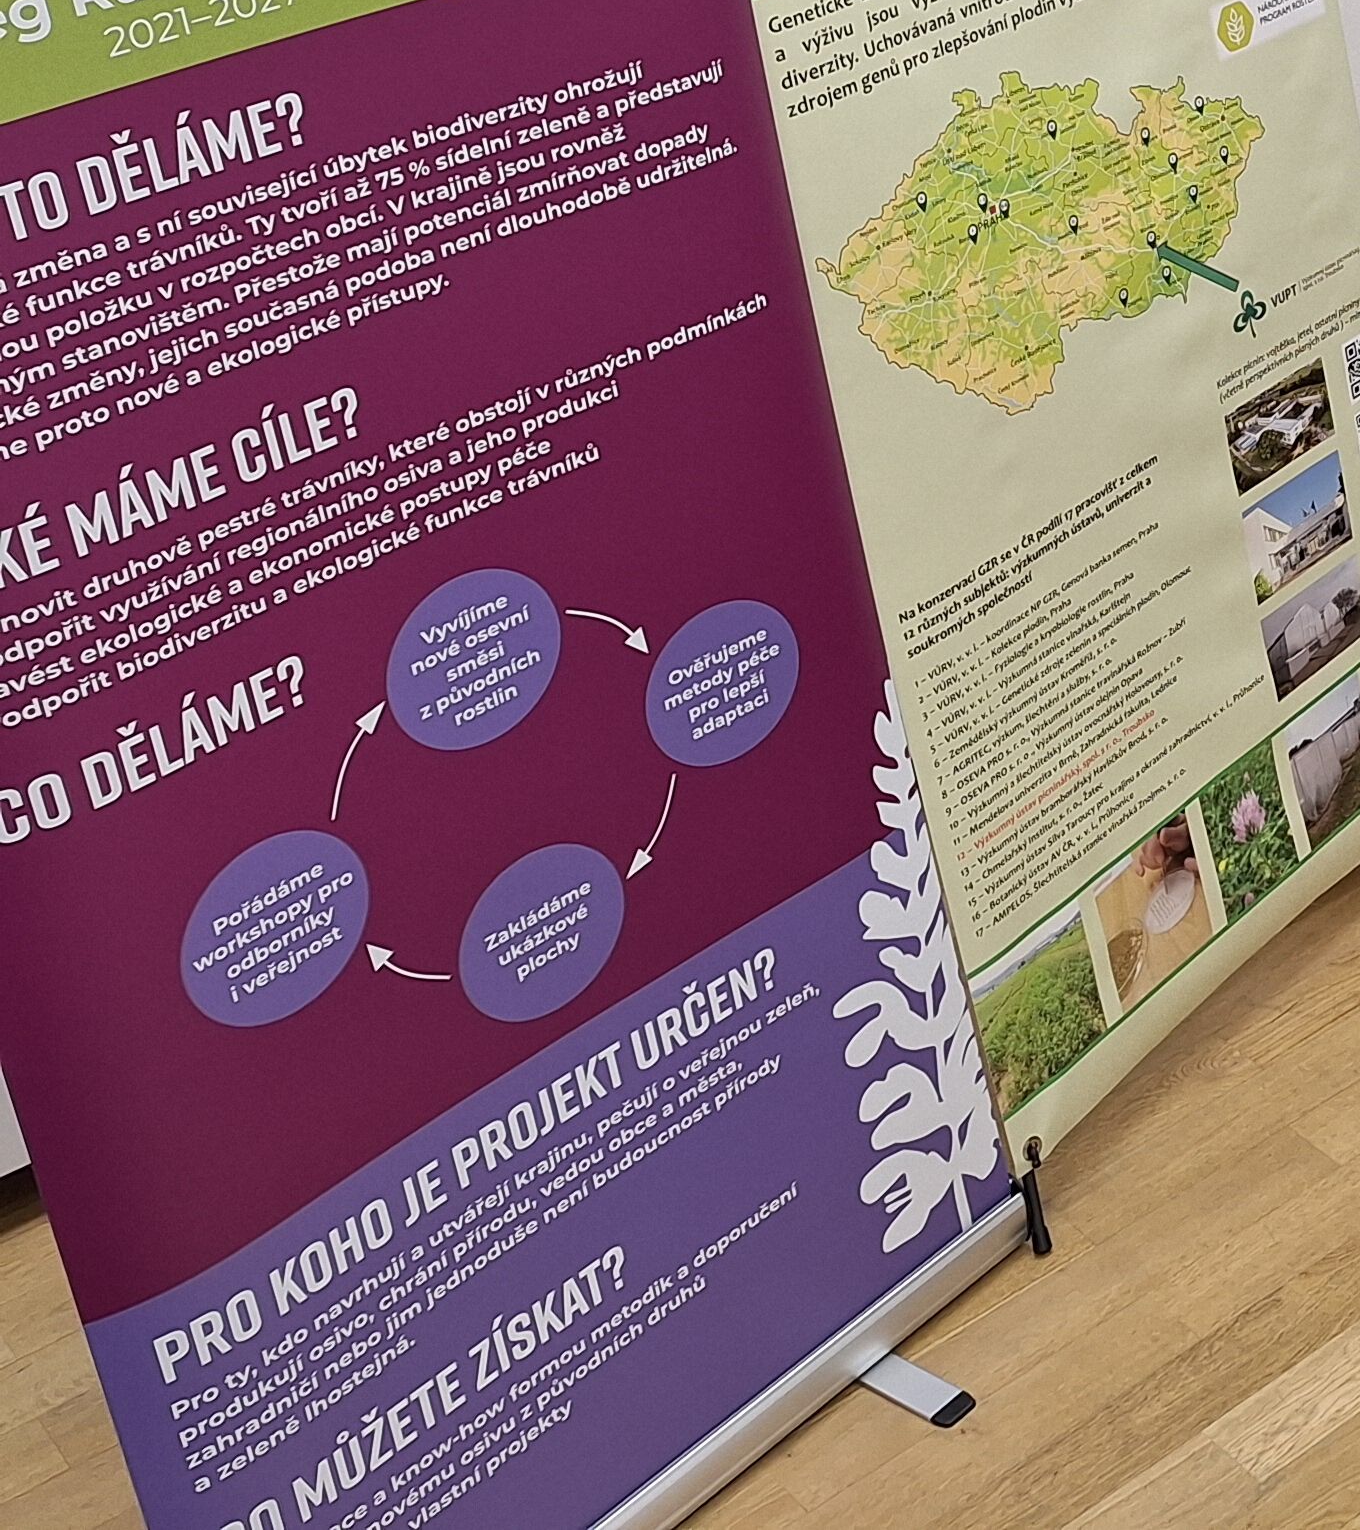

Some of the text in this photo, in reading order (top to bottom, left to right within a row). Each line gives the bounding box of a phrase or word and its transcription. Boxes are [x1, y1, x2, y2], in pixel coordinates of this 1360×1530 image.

[1260, 5, 1291, 25] PROGRAM
[0, 92, 303, 241] TO DĚLÁME?
[12, 59, 643, 288] změna a s ní související úbytek biodiverzity ohrožují
[1270, 283, 1298, 308] VUPT
[1216, 368, 1243, 390] Kolekce
[64, 443, 227, 558] MÁME
[231, 387, 358, 483] CÍLE?
[83, 293, 767, 599] druhově pestré trávníky, které obstojí v různých podmínkách
[898, 609, 916, 625] Na
[977, 556, 999, 577] GZR
[999, 550, 1013, 564] se
[1012, 544, 1020, 554] v
[1020, 533, 1036, 549] ČR
[1063, 508, 1073, 522] 17
[1074, 477, 1118, 518] pracovišť
[1119, 476, 1125, 486] z
[1125, 455, 1159, 481] celkem
[410, 603, 529, 676] nové osevní
[419, 596, 508, 644] Vyvíjíme
[419, 650, 541, 721] z původních
[446, 640, 505, 682] směsi
[663, 644, 780, 711] metody péče
[668, 629, 767, 685] Ověřujeme
[454, 686, 518, 727] rostlin
[688, 668, 765, 724] pro lepší
[691, 688, 769, 740] adaptaci
[80, 655, 304, 810] DĚLÁME?
[956, 766, 986, 790] OSEVA
[987, 752, 1005, 769] PRO
[192, 872, 354, 972] workshopy pro
[212, 864, 324, 936] Pořádáme
[483, 882, 591, 952] Zakládáme
[498, 903, 588, 966] ukázkové
[227, 906, 334, 979] odborníky
[229, 927, 343, 1003] i veřejnost
[516, 932, 580, 983] plochy
[152, 948, 775, 1385] PRO KOHO JE PROJEKT URČEN?
[291, 1245, 625, 1525] MŮŽETE ZÍSKAT?
